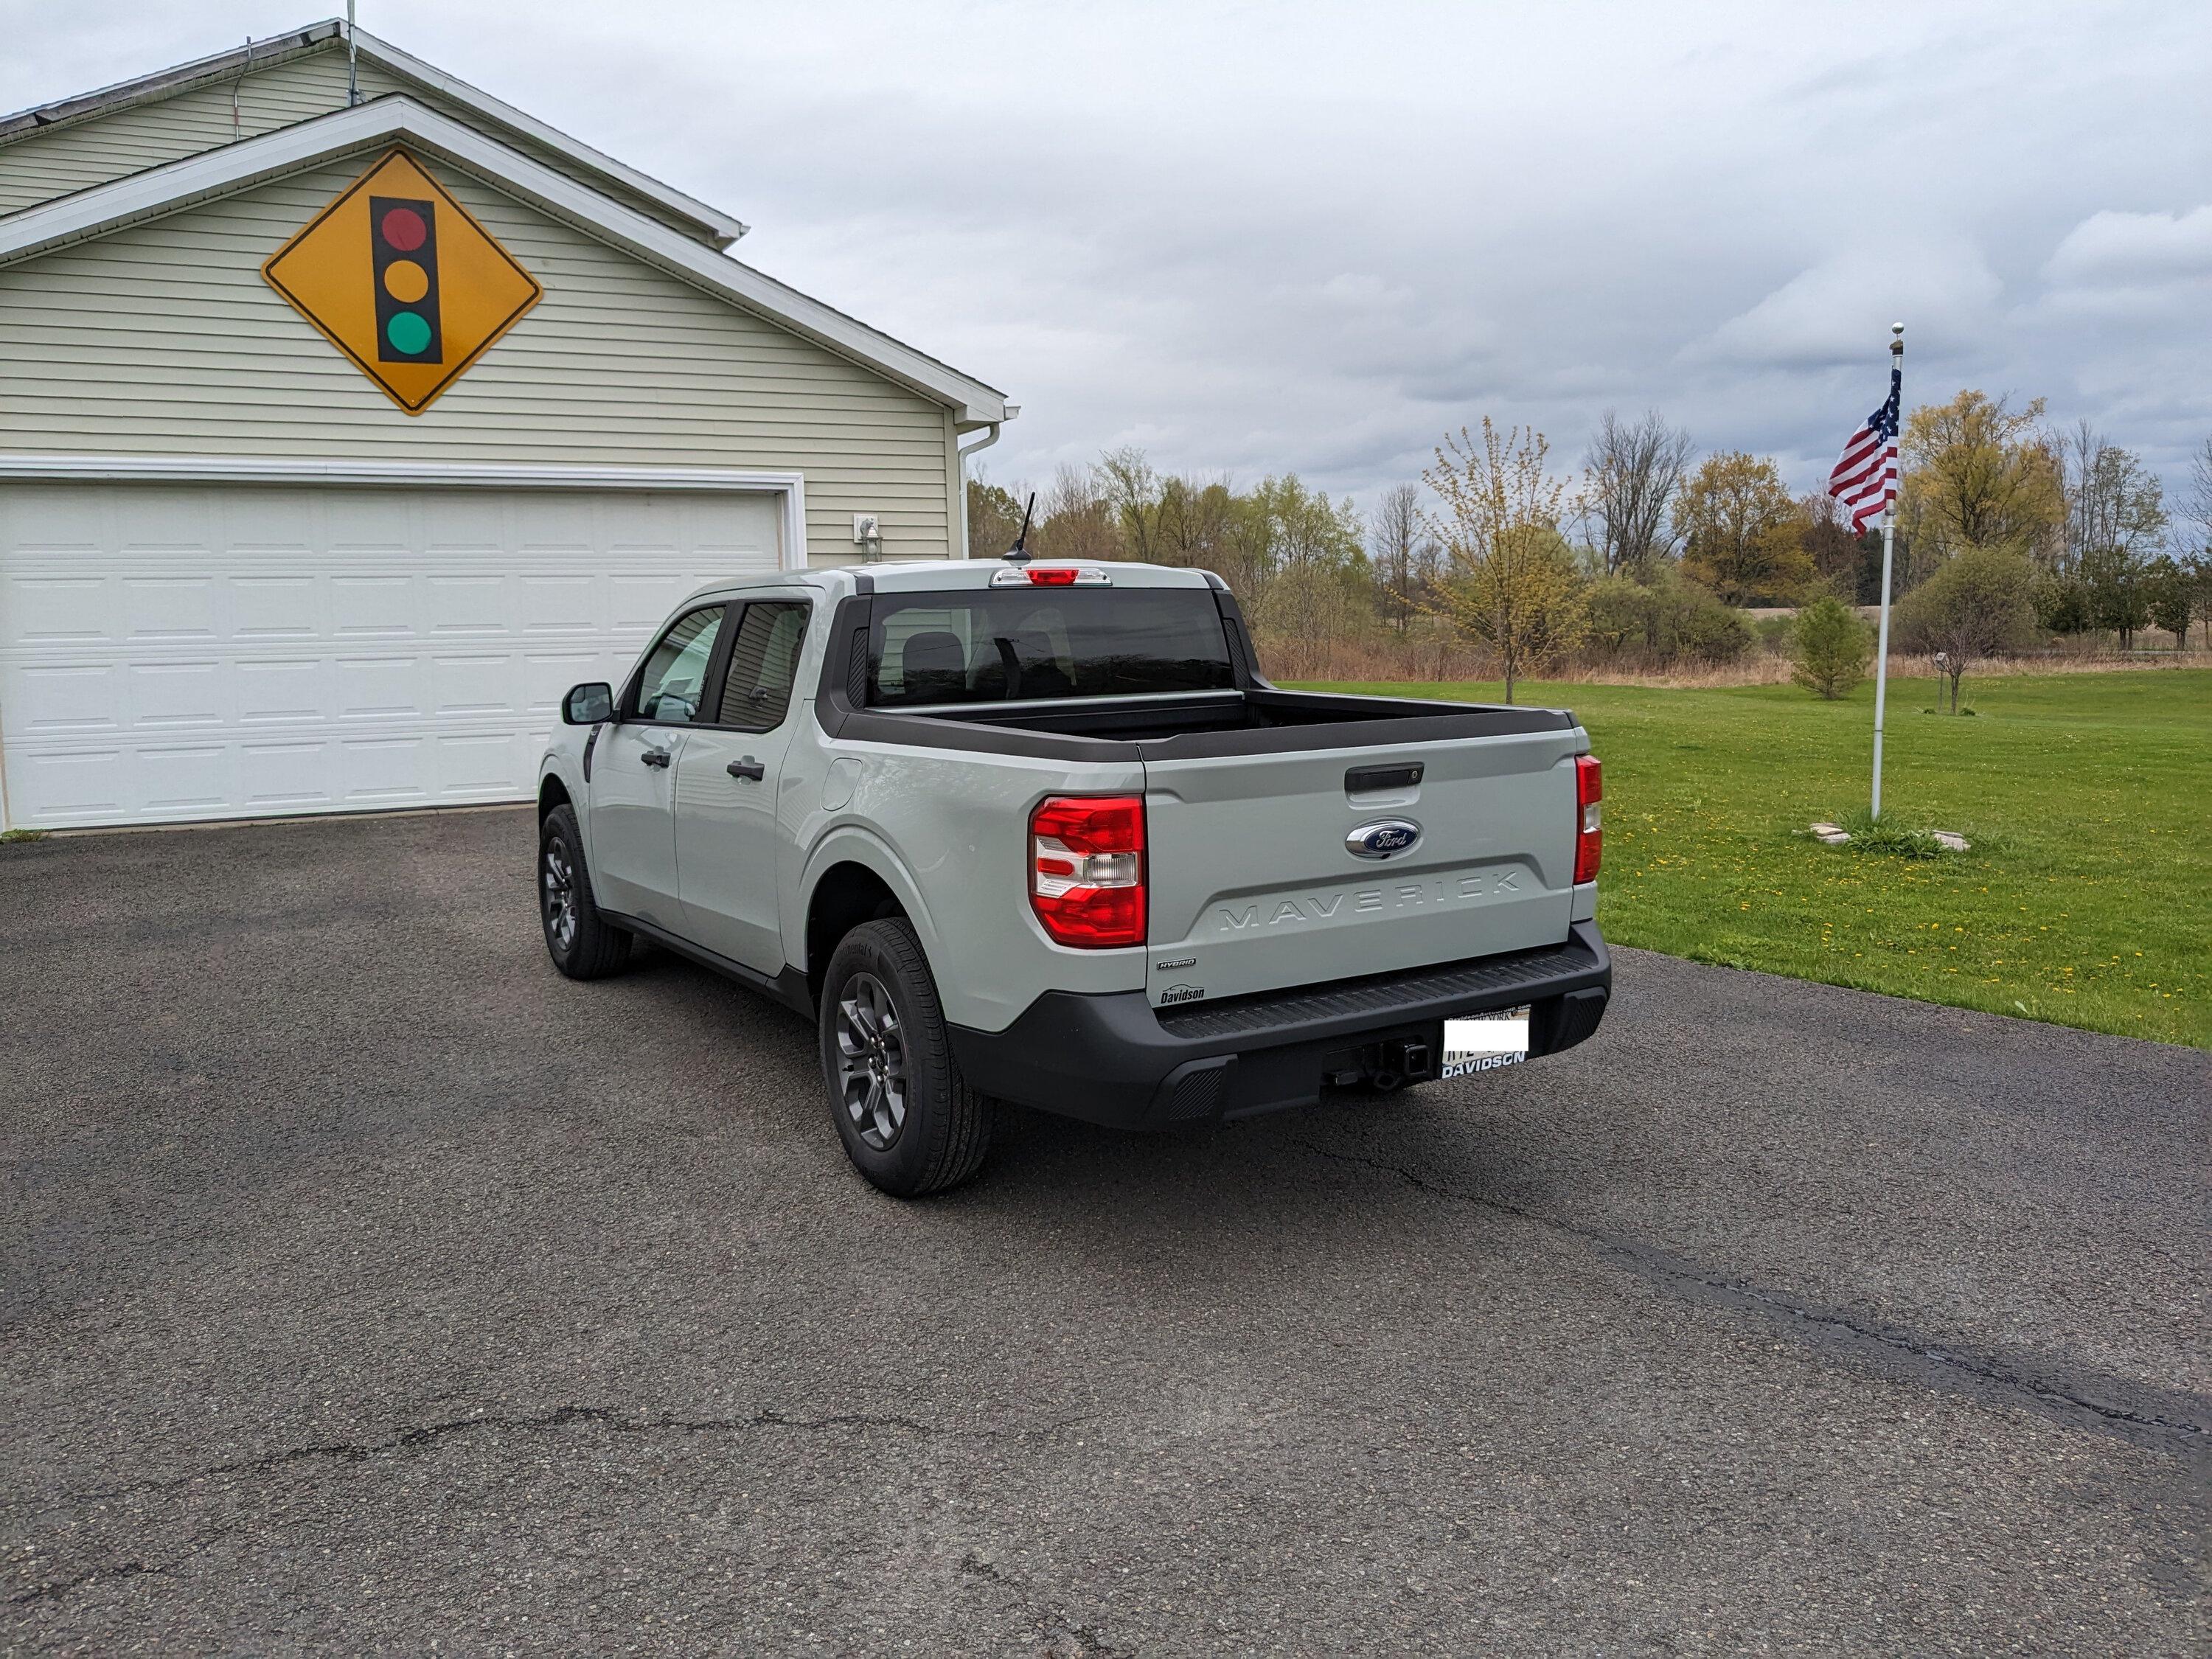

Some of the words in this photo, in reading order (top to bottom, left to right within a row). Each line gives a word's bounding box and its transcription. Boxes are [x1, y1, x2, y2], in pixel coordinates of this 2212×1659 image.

[1376, 830, 1408, 848] Ford
[1218, 871, 1520, 931] MAVERICK
[1160, 959, 1195, 968] HYBRID
[1161, 988, 1205, 1004] Davidson
[1441, 1051, 1526, 1079] DAVIDSON
